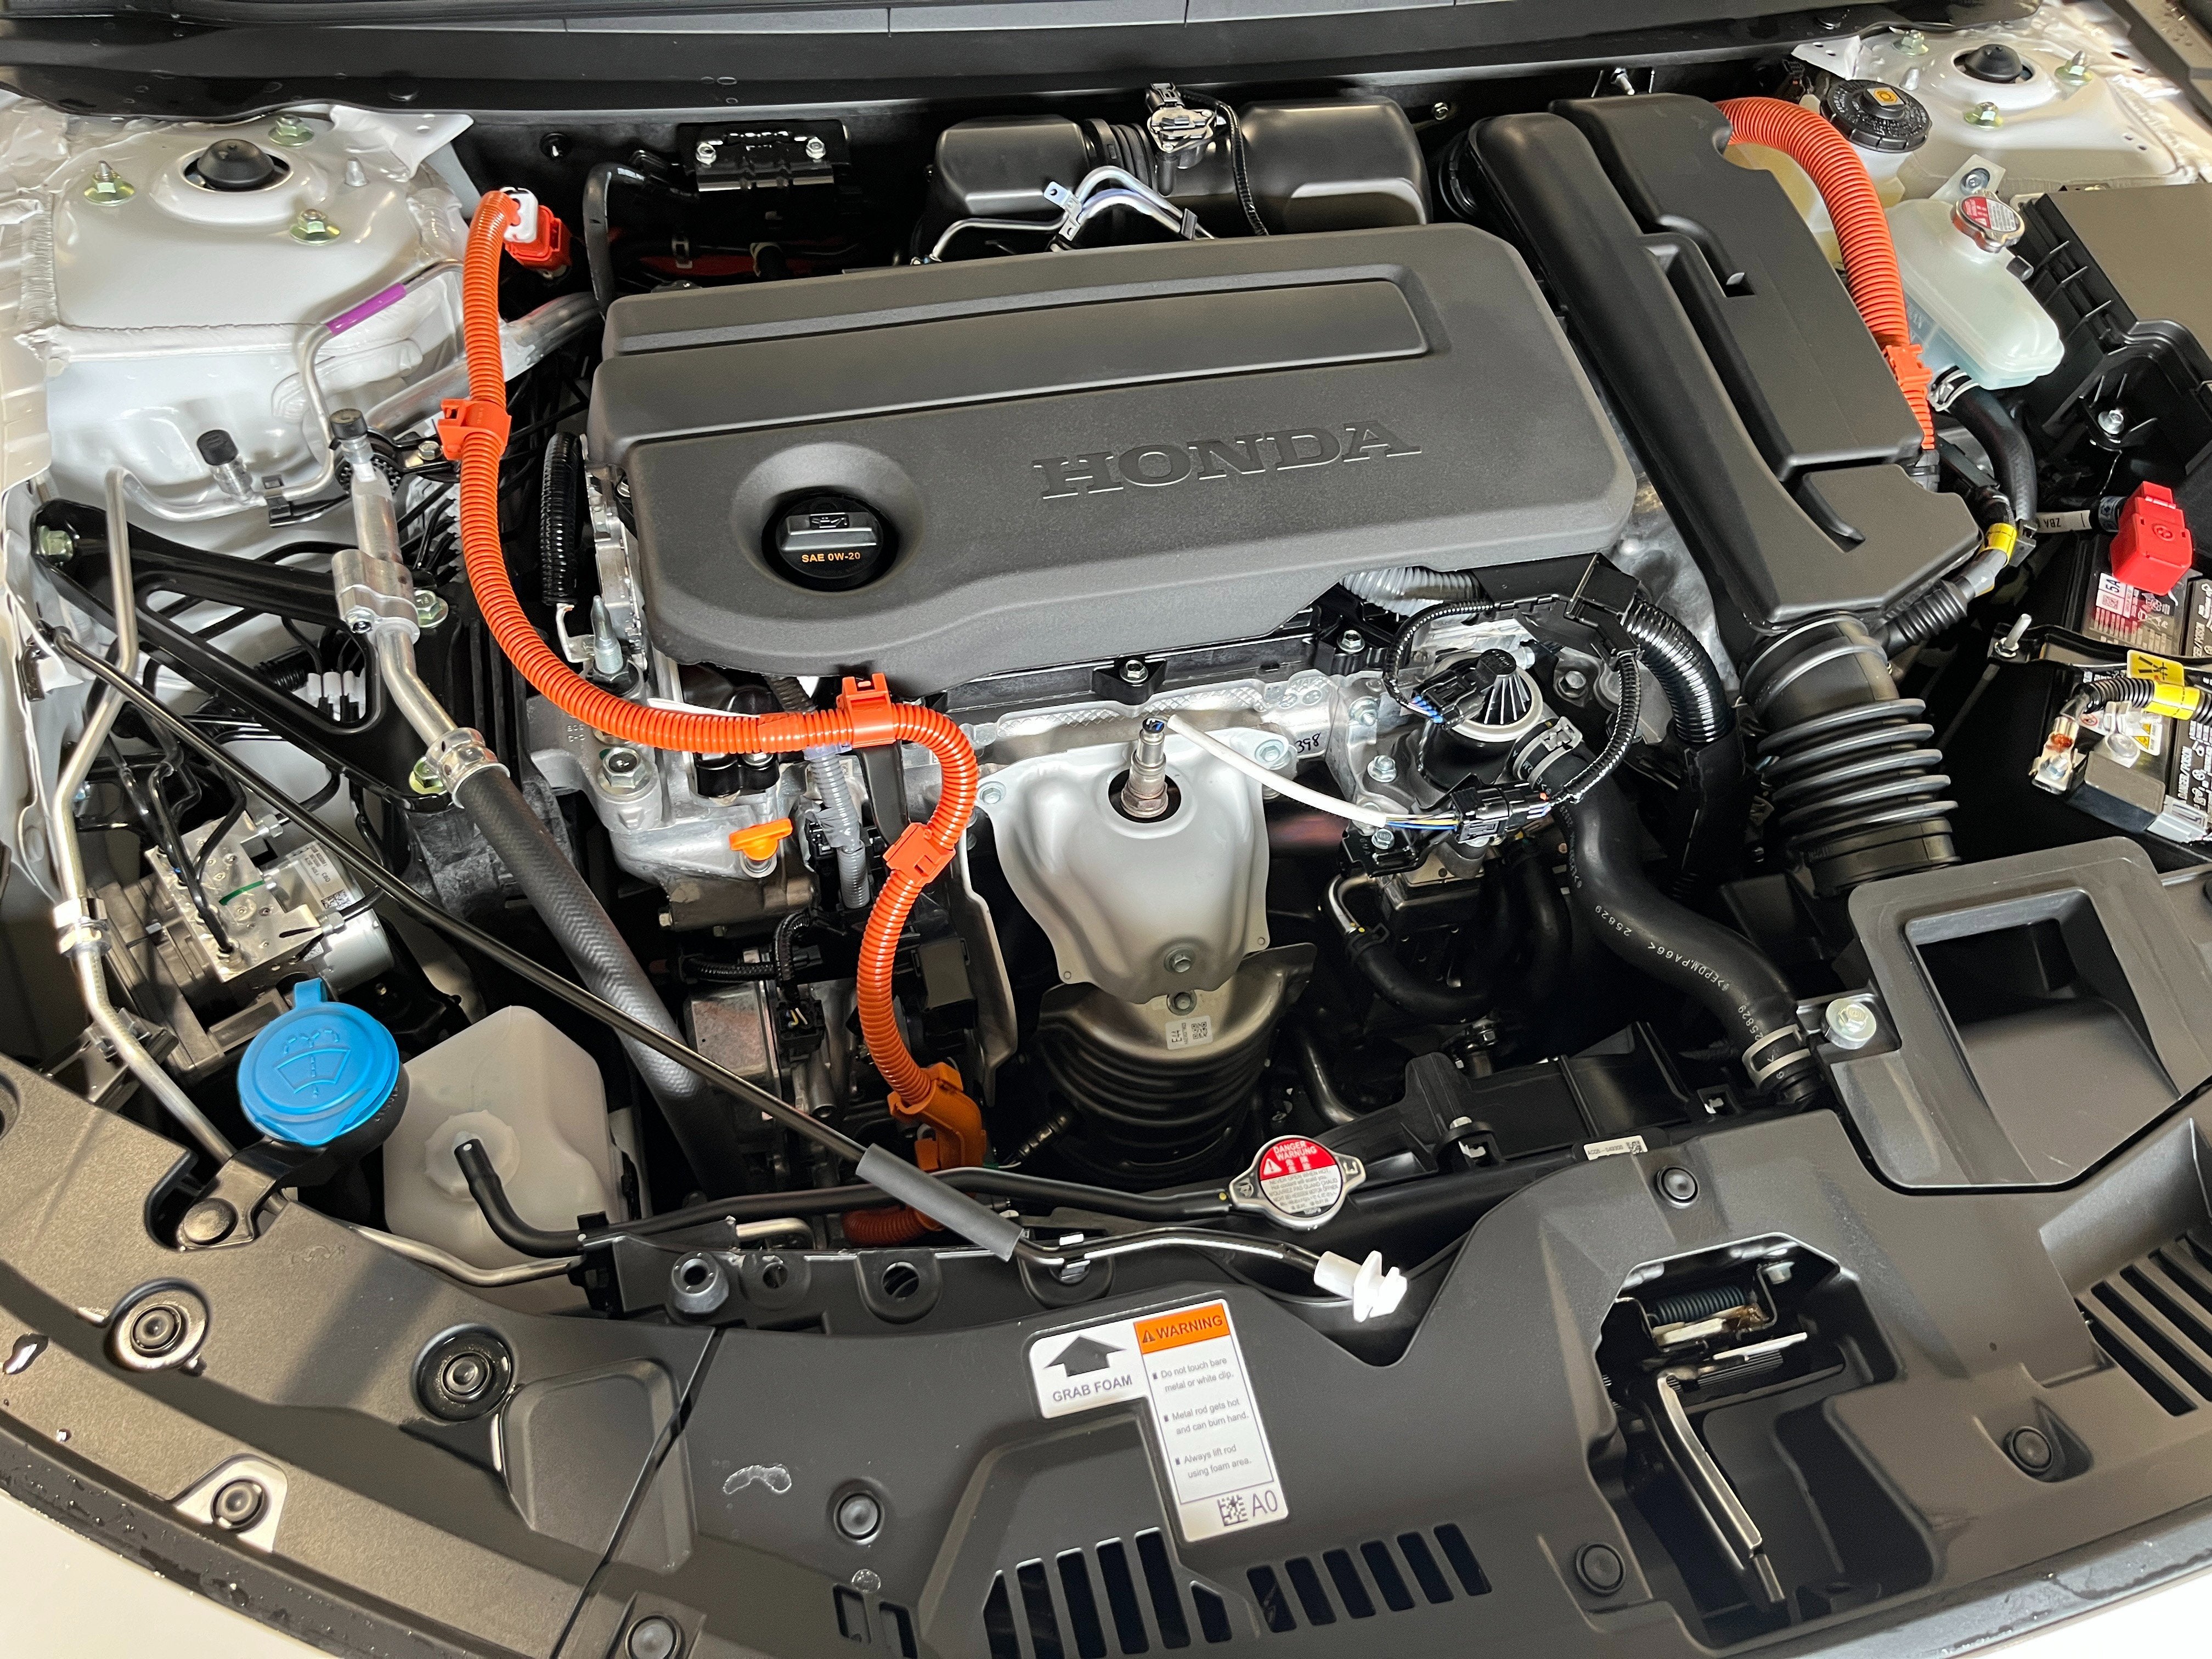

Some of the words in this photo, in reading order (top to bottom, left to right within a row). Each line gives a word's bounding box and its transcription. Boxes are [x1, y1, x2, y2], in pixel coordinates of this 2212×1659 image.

[1032, 420, 1422, 500] HONDA
[2044, 517, 2061, 528] ZBA
[802, 553, 825, 563] SAE
[827, 552, 861, 561] 0W-20
[2106, 579, 2121, 593] 5A
[1295, 732, 1321, 753] 398
[1595, 905, 1632, 936] 25829
[1738, 1005, 1764, 1041] 25829
[1273, 1141, 1307, 1153] DANGER
[1276, 1146, 1317, 1161] WARNUNG
[1156, 1315, 1223, 1339] WARNING
[1161, 1370, 1172, 1378] Do
[1174, 1366, 1187, 1374] not
[1188, 1362, 1208, 1372] touch
[1210, 1358, 1227, 1367] bare
[1052, 1384, 1091, 1402] GRAB
[1094, 1374, 1132, 1392] FOAM
[1165, 1380, 1186, 1392] metal
[1197, 1375, 1217, 1384] white
[1218, 1371, 1234, 1380] clip.
[1172, 1408, 1193, 1421] Metal
[1195, 1405, 1207, 1415] rod
[1209, 1402, 1226, 1413] gets
[1227, 1398, 1240, 1408] hot
[1176, 1425, 1190, 1435] and
[1193, 1422, 1207, 1431] can
[1208, 1417, 1226, 1427] burn
[1227, 1410, 1249, 1423] hand.
[1184, 1452, 1212, 1464] Always
[1212, 1447, 1222, 1457] lift
[1224, 1444, 1237, 1454] rod
[1188, 1468, 1209, 1479] using
[1210, 1462, 1230, 1473] foam
[1232, 1457, 1251, 1468] area.
